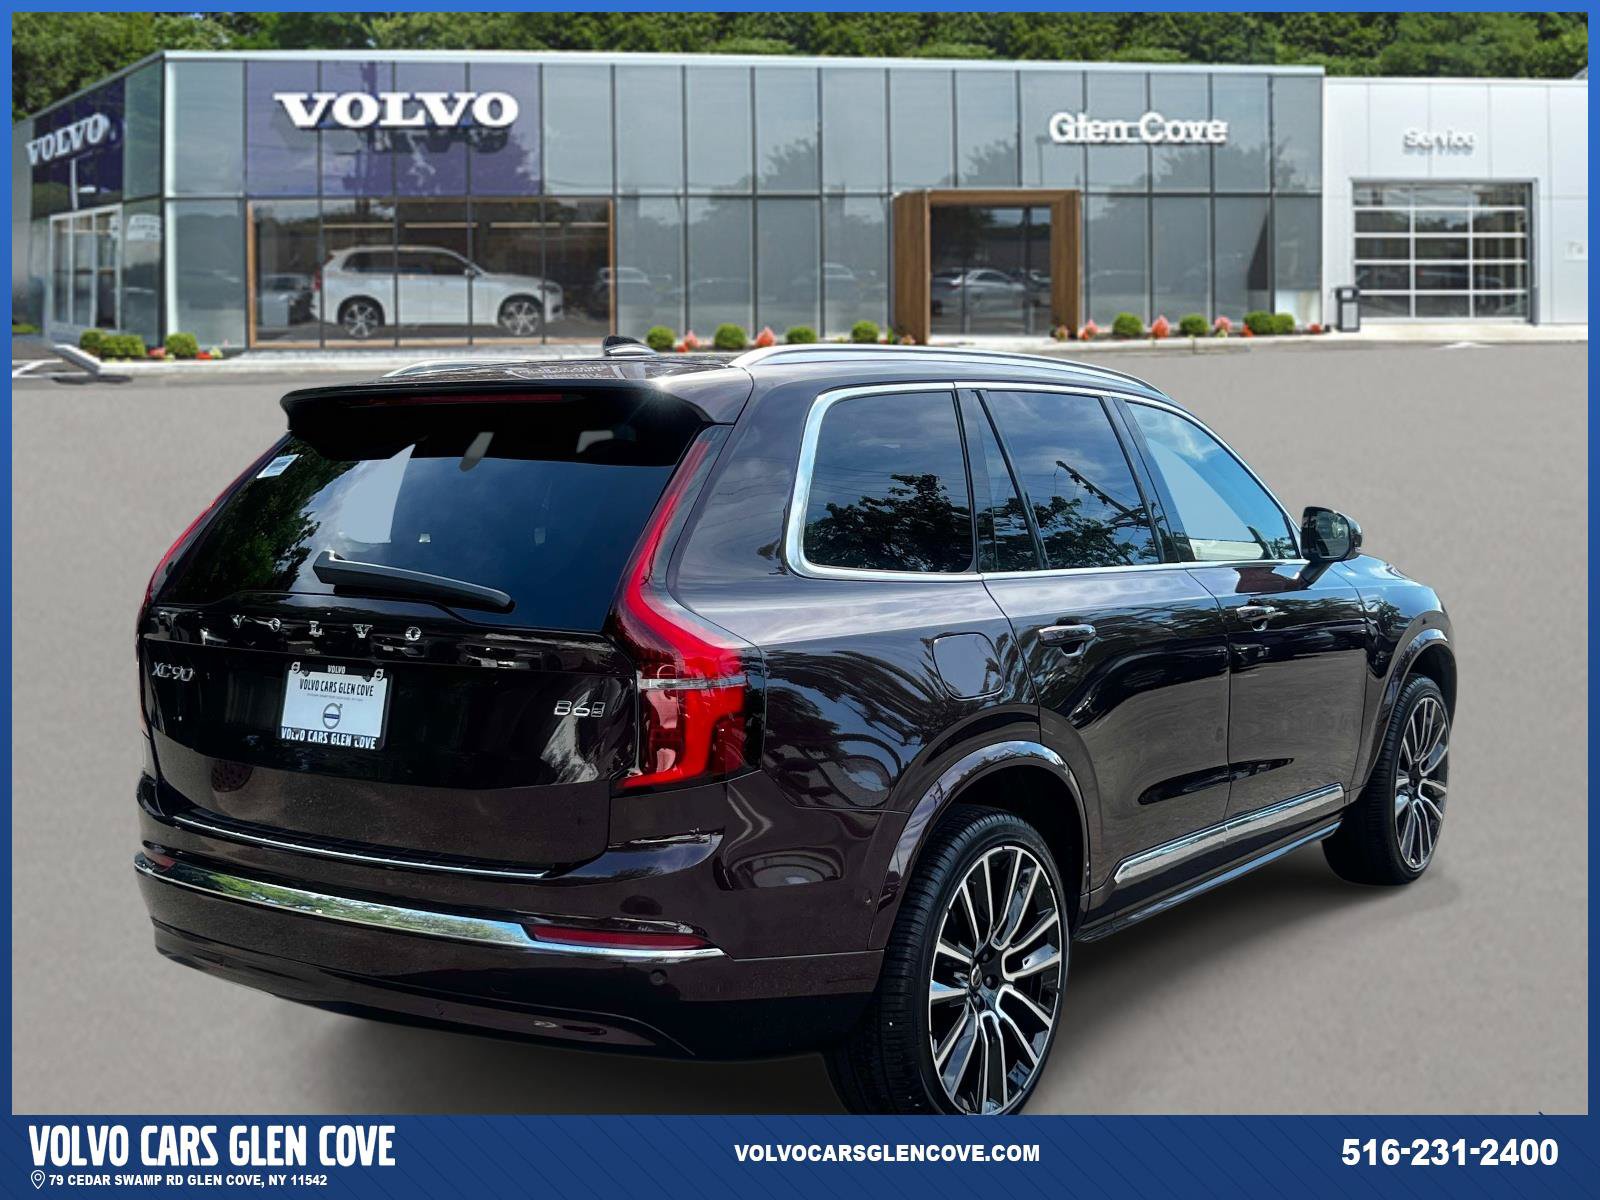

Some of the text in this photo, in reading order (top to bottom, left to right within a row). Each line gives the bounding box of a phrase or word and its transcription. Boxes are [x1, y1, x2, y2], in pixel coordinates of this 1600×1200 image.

[273, 92, 519, 128] VOLVO
[1049, 112, 1228, 144] Glen Cove
[25, 112, 110, 166] VOLVO
[231, 614, 422, 641] VOLVO
[151, 662, 194, 681] XC90
[327, 665, 346, 674] VOLVO
[300, 678, 374, 696] VOLVO CARS GLEN COVE
[553, 700, 591, 717] B6
[307, 730, 328, 744] CARS
[330, 734, 352, 747] GLEN
